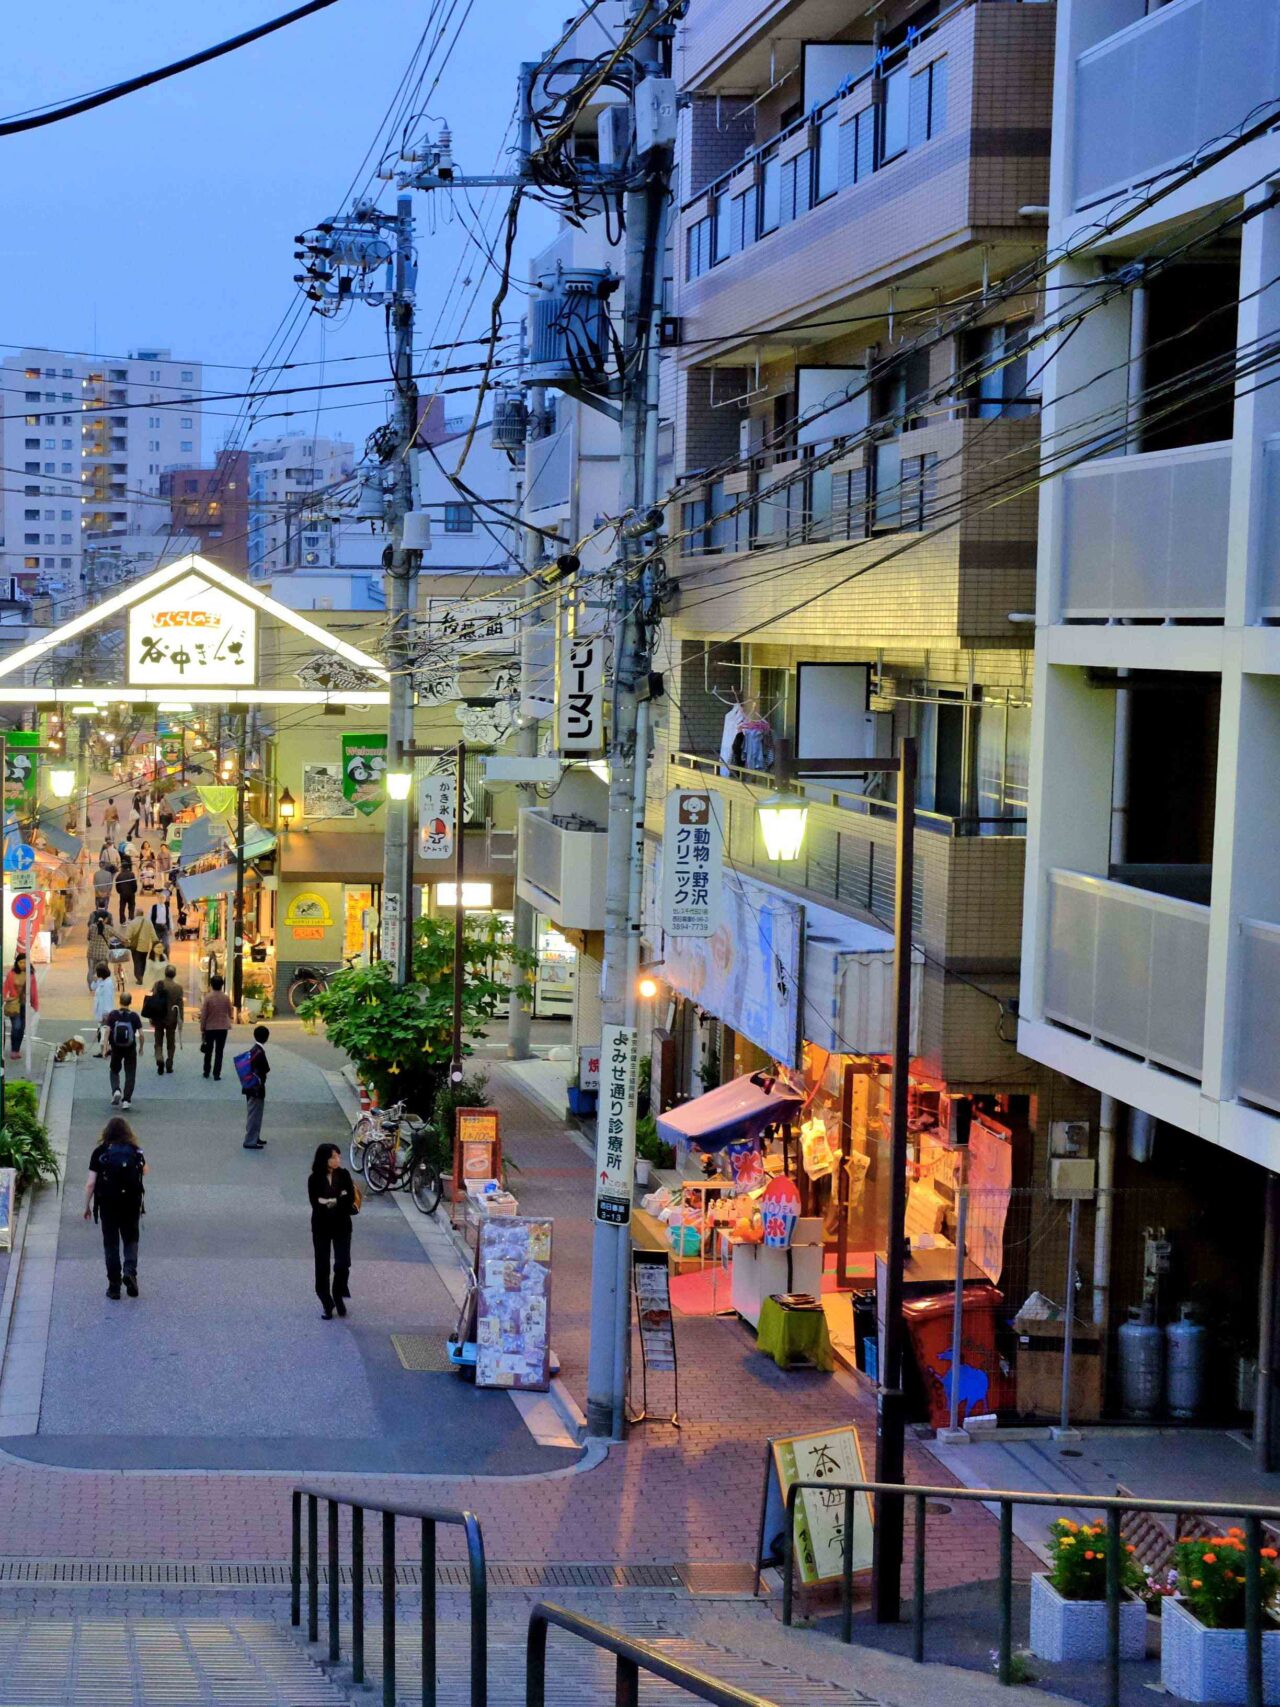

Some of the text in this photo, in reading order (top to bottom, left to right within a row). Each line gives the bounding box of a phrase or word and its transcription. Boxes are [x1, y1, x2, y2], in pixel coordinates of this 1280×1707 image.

[139, 625, 246, 674] 谷中ぎんざ
[439, 782, 450, 815] かき氷
[674, 828, 691, 904] クリニック
[691, 828, 711, 906] 動物・野沢
[606, 1030, 629, 1171] よみせ通り診療所
[730, 1151, 765, 1185] 氷
[766, 1217, 787, 1238] 氷
